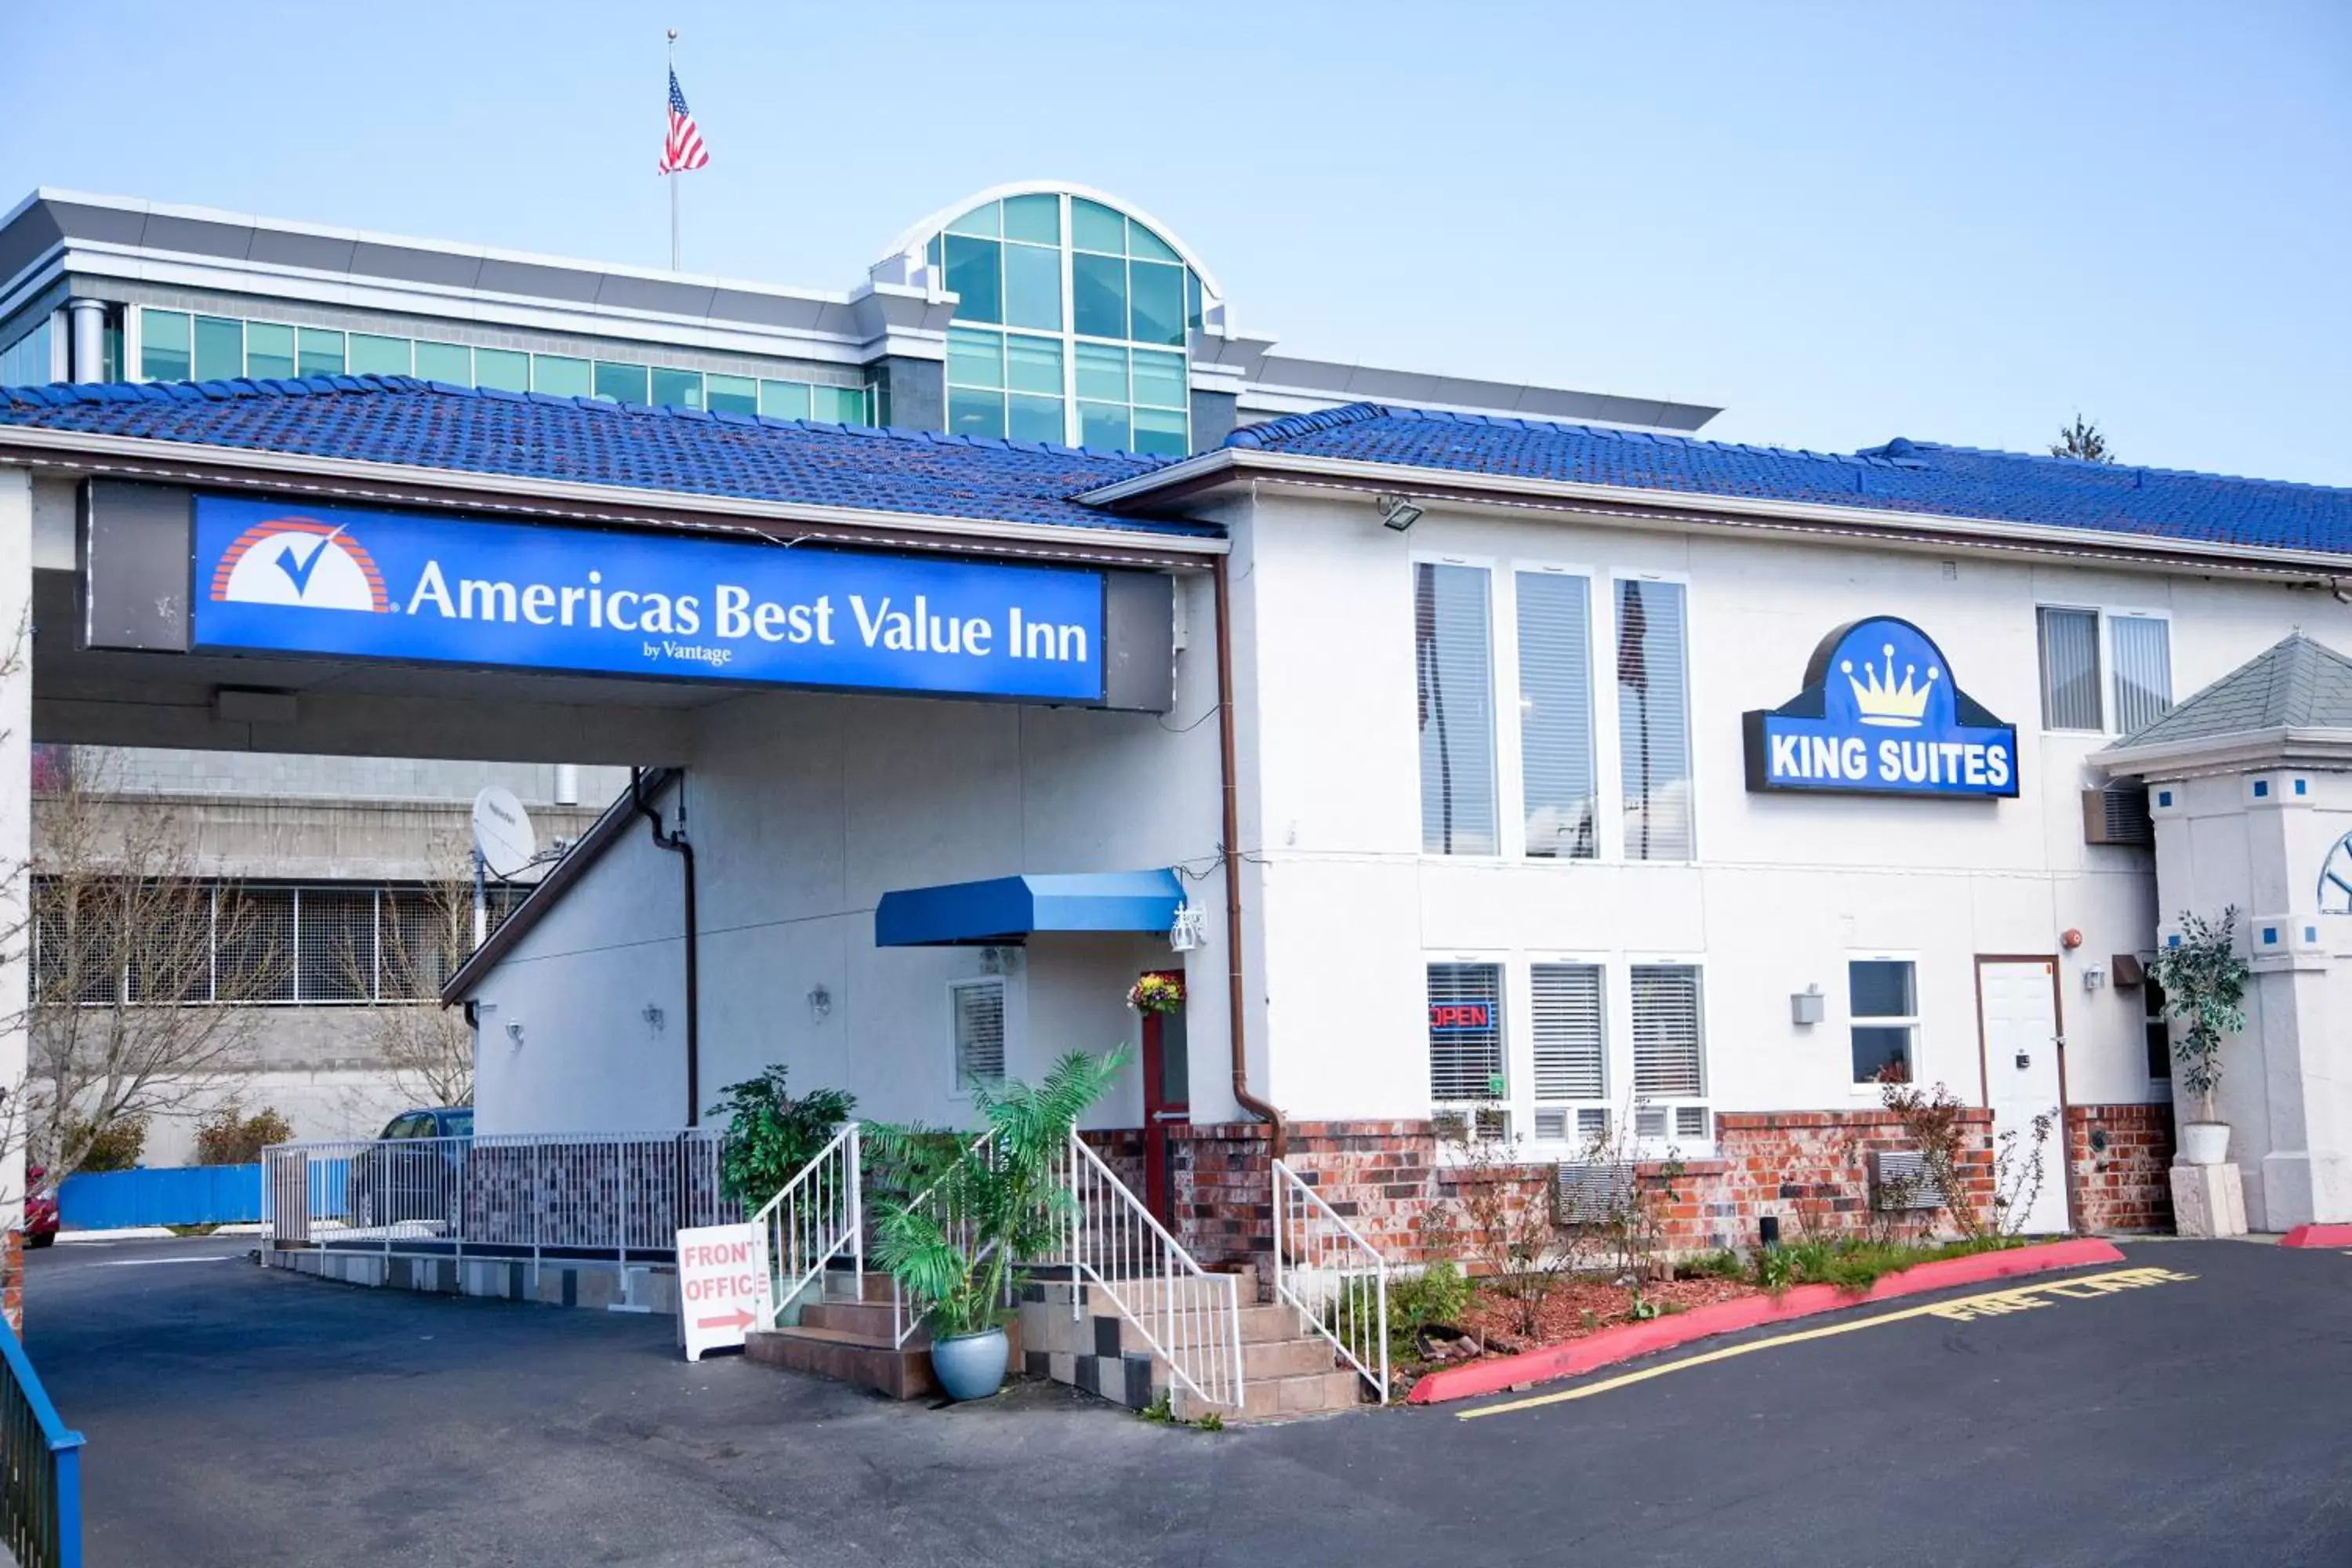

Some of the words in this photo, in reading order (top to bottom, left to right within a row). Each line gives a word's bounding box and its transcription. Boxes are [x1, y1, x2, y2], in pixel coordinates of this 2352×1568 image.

[407, 560, 700, 636] Americas
[715, 584, 835, 646] Best
[849, 595, 993, 656] Value
[1009, 608, 1087, 662] Inn
[643, 640, 660, 662] by
[662, 641, 731, 666] Vantage
[1771, 735, 1867, 780] KING
[1879, 739, 2009, 786] SUITES
[685, 1272, 768, 1301] OFFICE
